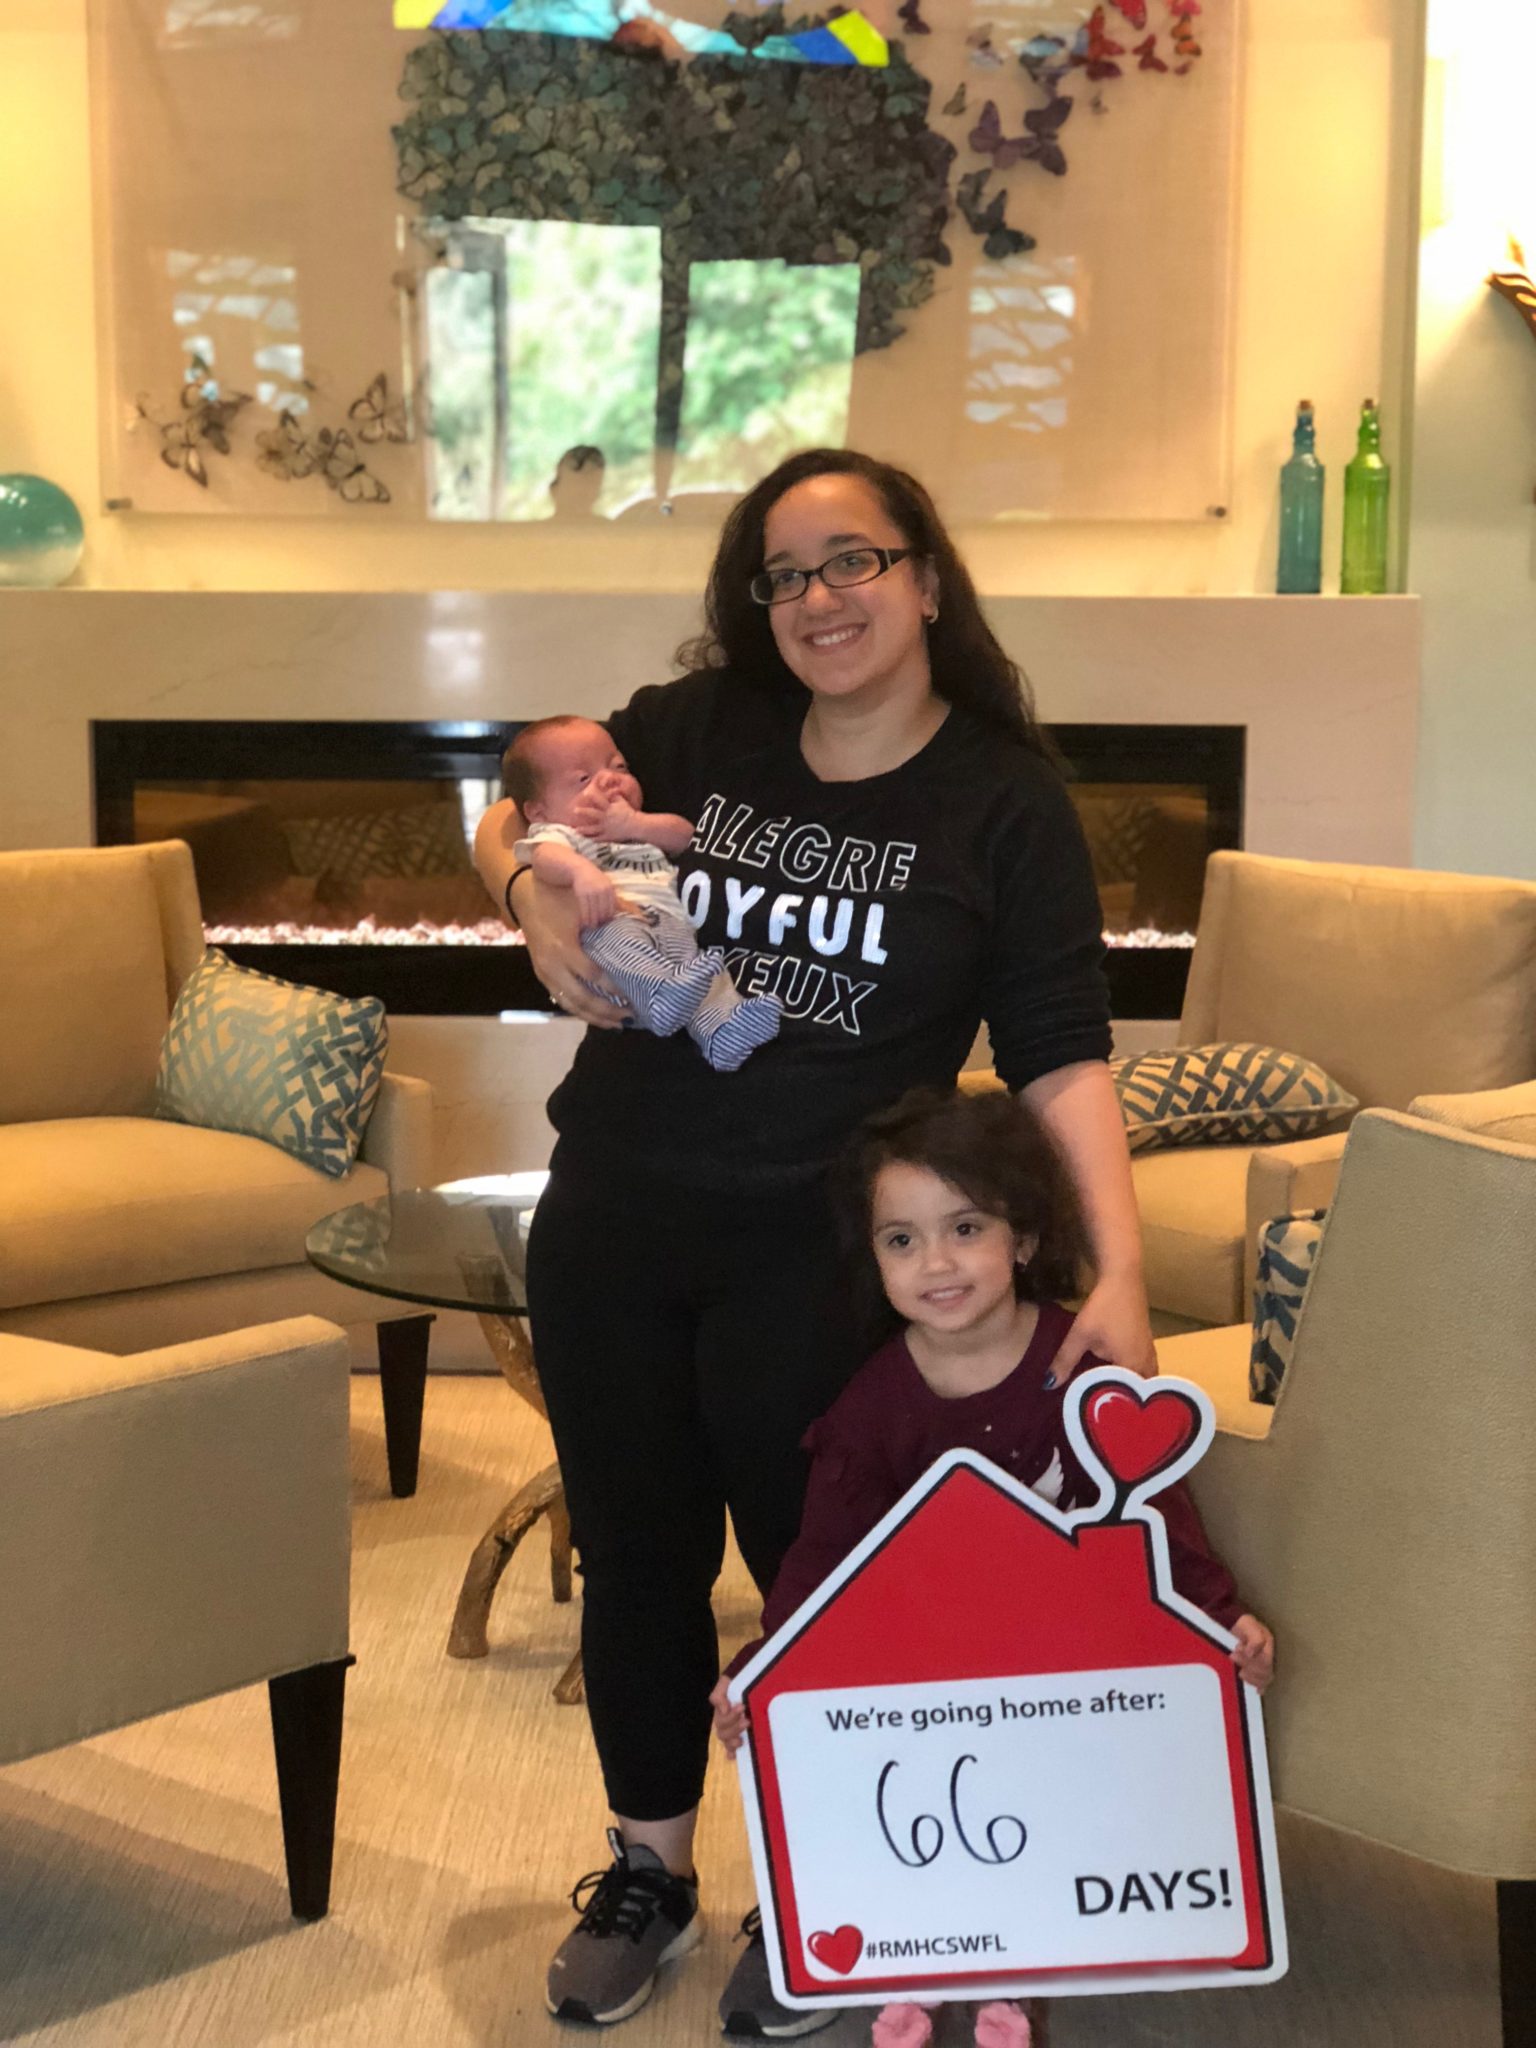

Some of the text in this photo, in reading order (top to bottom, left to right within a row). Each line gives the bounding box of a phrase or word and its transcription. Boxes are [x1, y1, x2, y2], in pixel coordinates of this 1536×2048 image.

[689, 793, 917, 893] ALEGRE
[681, 869, 888, 965] OYFUL
[825, 1688, 1166, 1732] We're going home after:
[876, 1754, 1028, 1868] 66
[1074, 1867, 1233, 1916] DAYS!
[865, 1933, 1007, 1959] #RMHCSWFL
